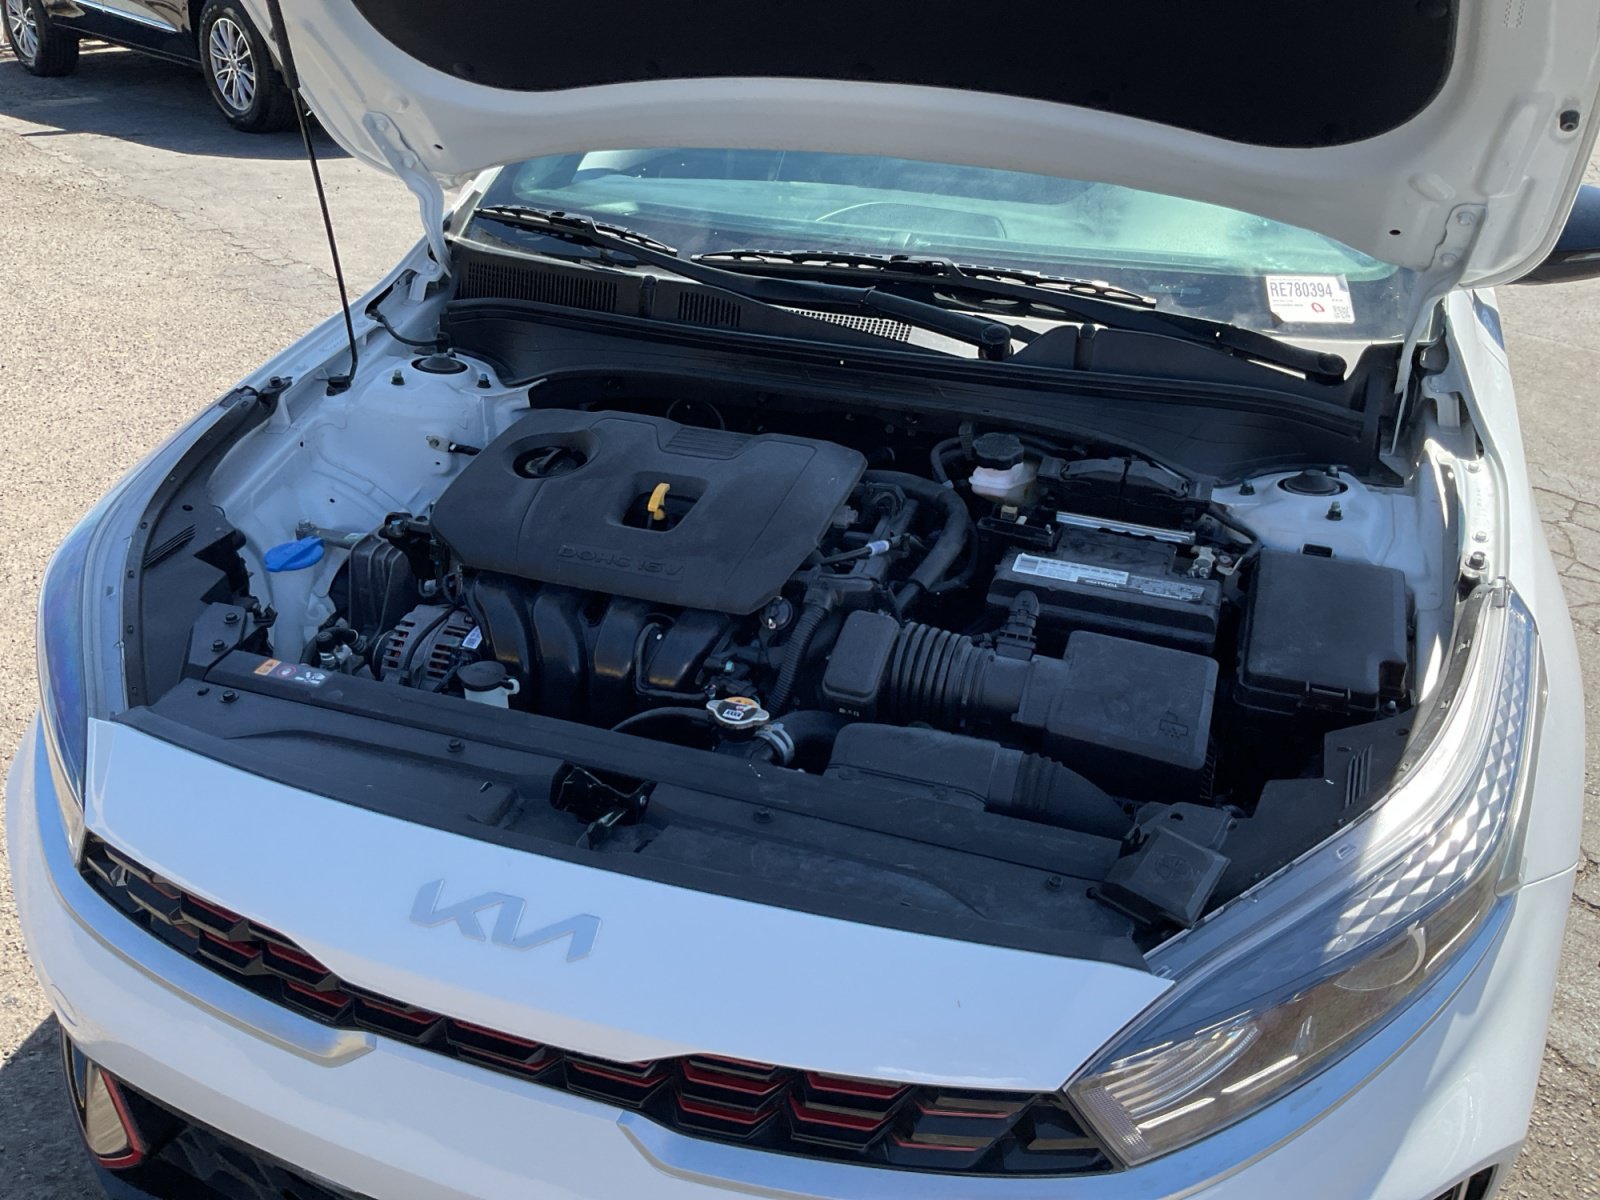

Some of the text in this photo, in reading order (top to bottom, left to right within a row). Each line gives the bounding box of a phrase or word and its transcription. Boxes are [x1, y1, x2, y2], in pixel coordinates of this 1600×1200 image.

[1270, 282, 1333, 298] RE780394
[558, 545, 631, 568] DOHC
[410, 879, 602, 963] KIA
